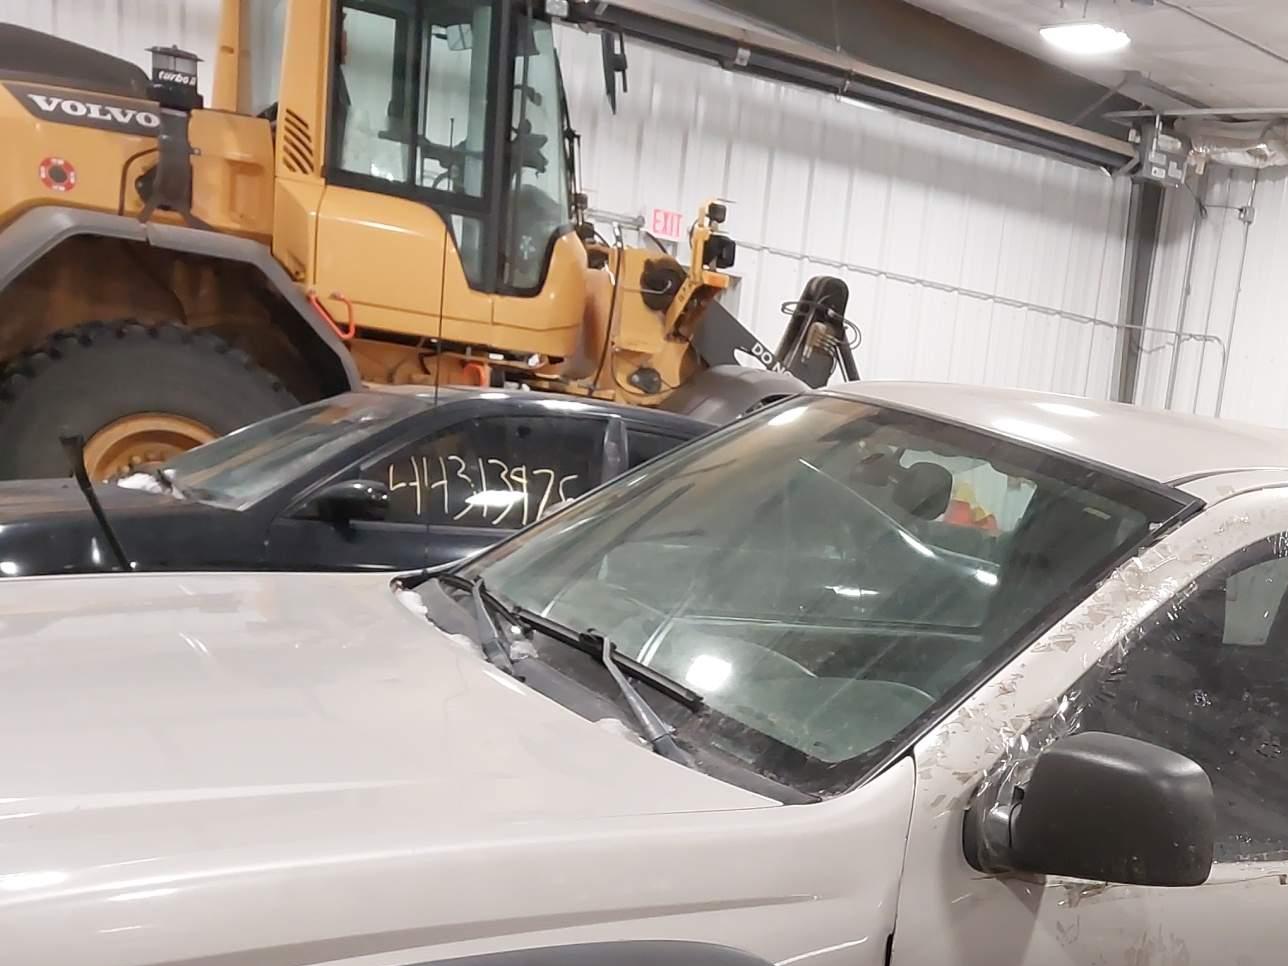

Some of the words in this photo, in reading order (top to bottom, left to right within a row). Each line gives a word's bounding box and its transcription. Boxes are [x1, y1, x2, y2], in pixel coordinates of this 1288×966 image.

[159, 70, 189, 85] turbo
[27, 93, 160, 128] VOLVO
[653, 208, 683, 239] EXIT
[751, 342, 773, 365] DO
